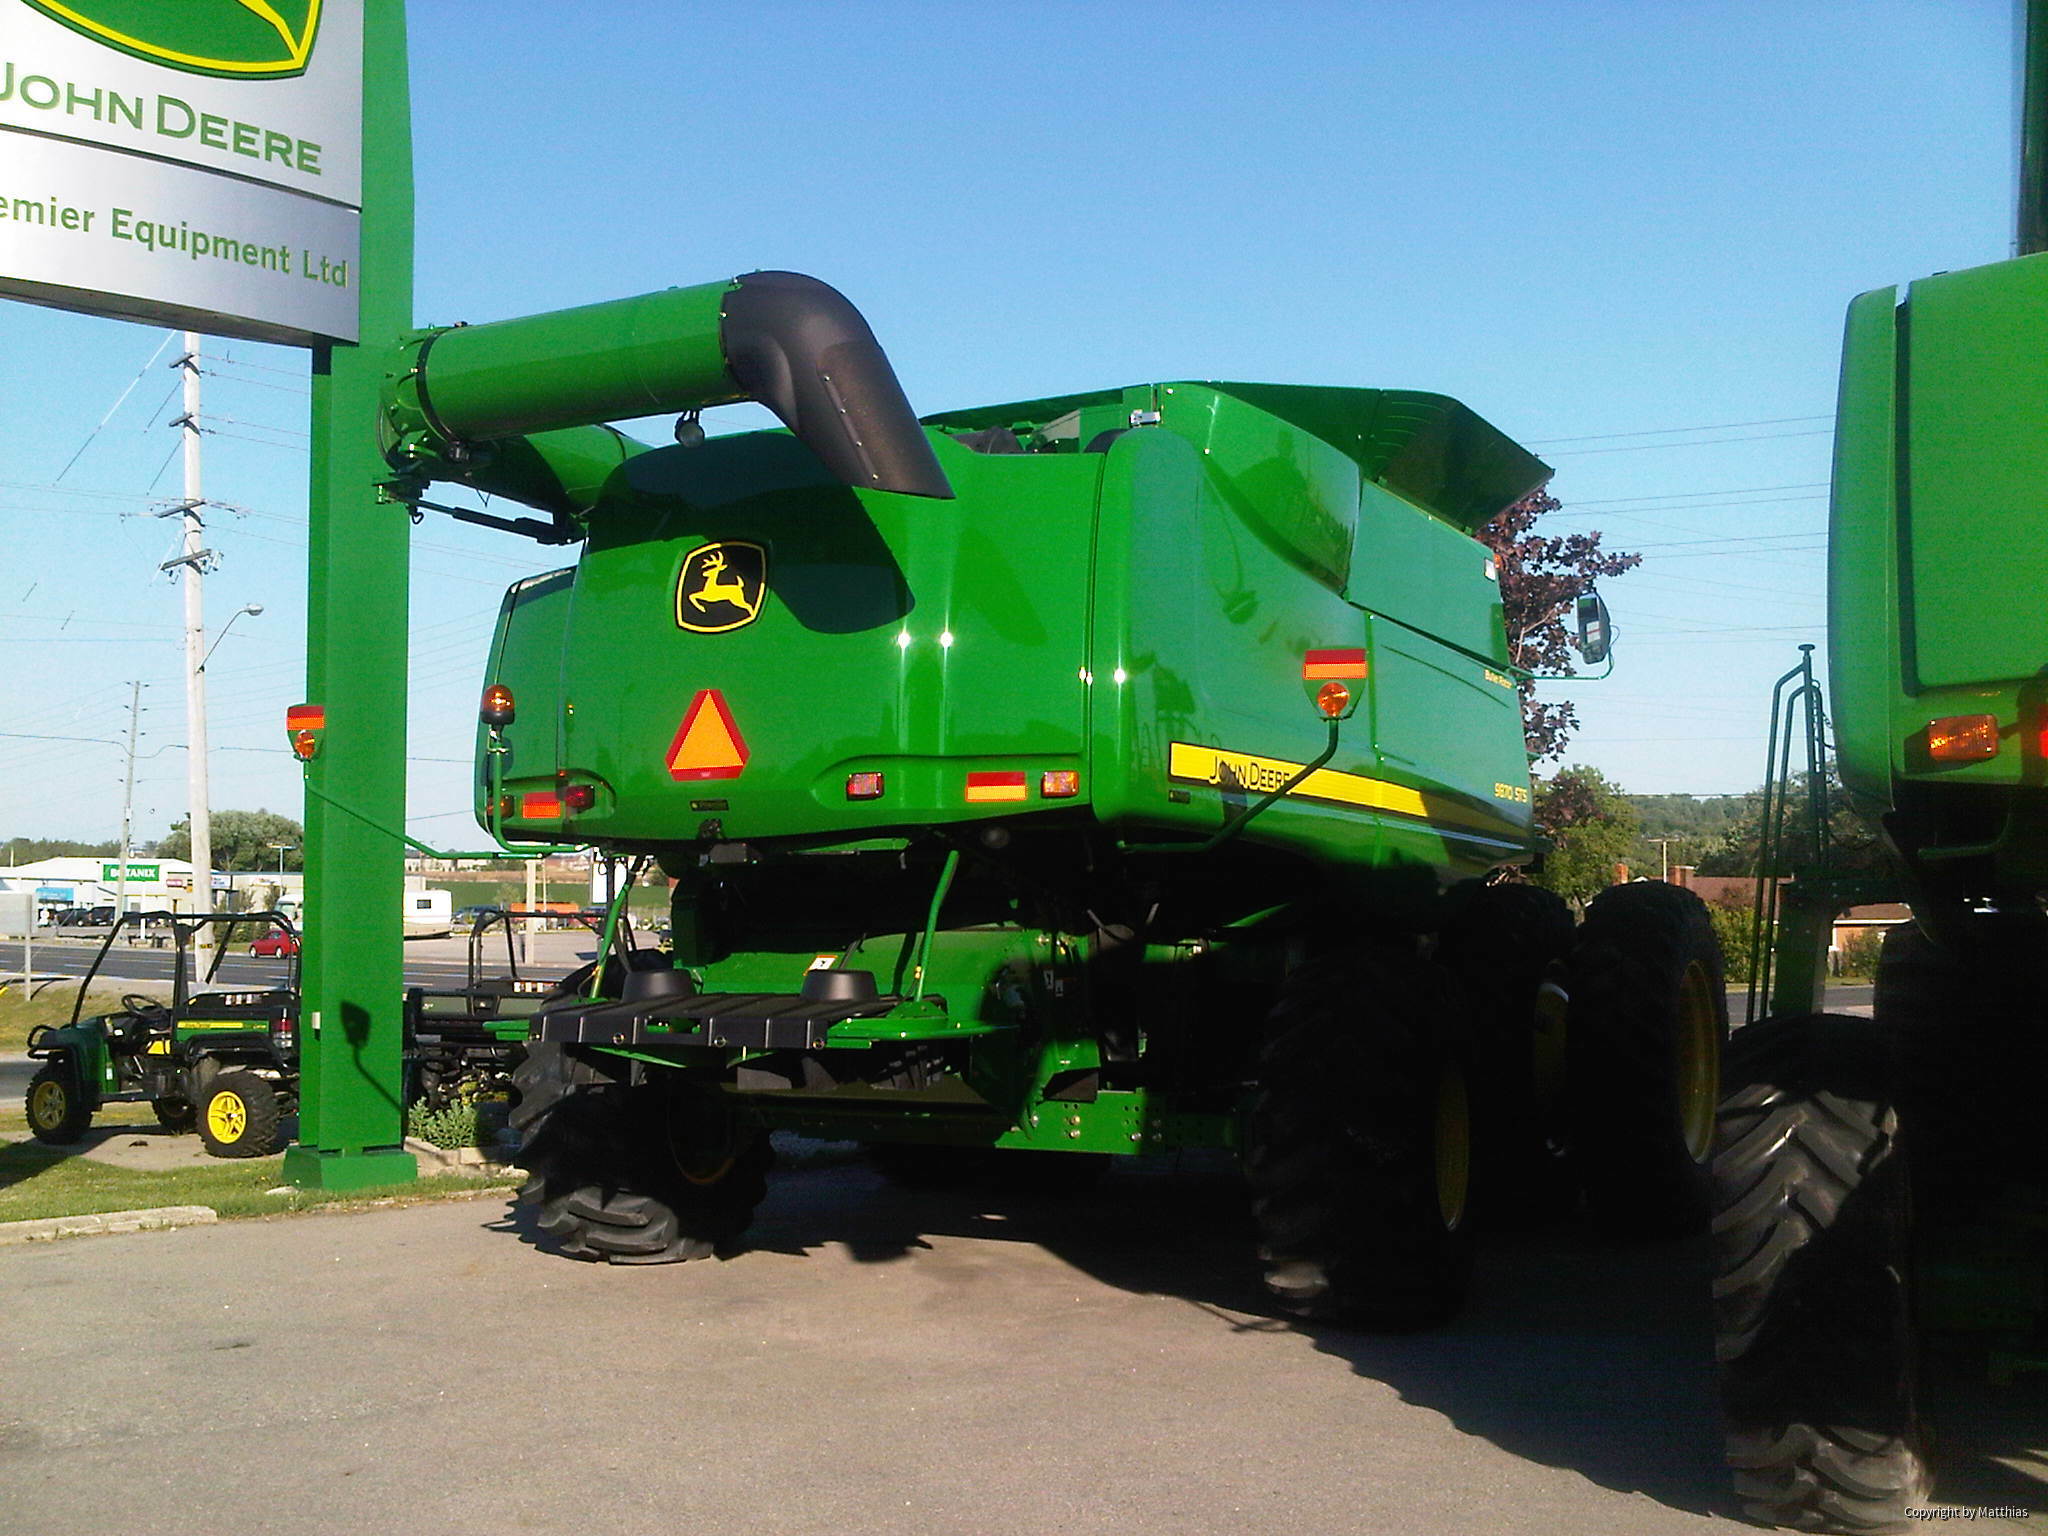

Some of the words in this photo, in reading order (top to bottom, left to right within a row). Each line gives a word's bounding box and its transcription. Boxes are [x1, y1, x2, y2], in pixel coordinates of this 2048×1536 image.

[0, 62, 143, 130] JOHN
[157, 95, 322, 176] DEERE
[112, 208, 291, 274] Equipment
[303, 249, 348, 288] Ltd
[1209, 756, 1247, 785] JHN
